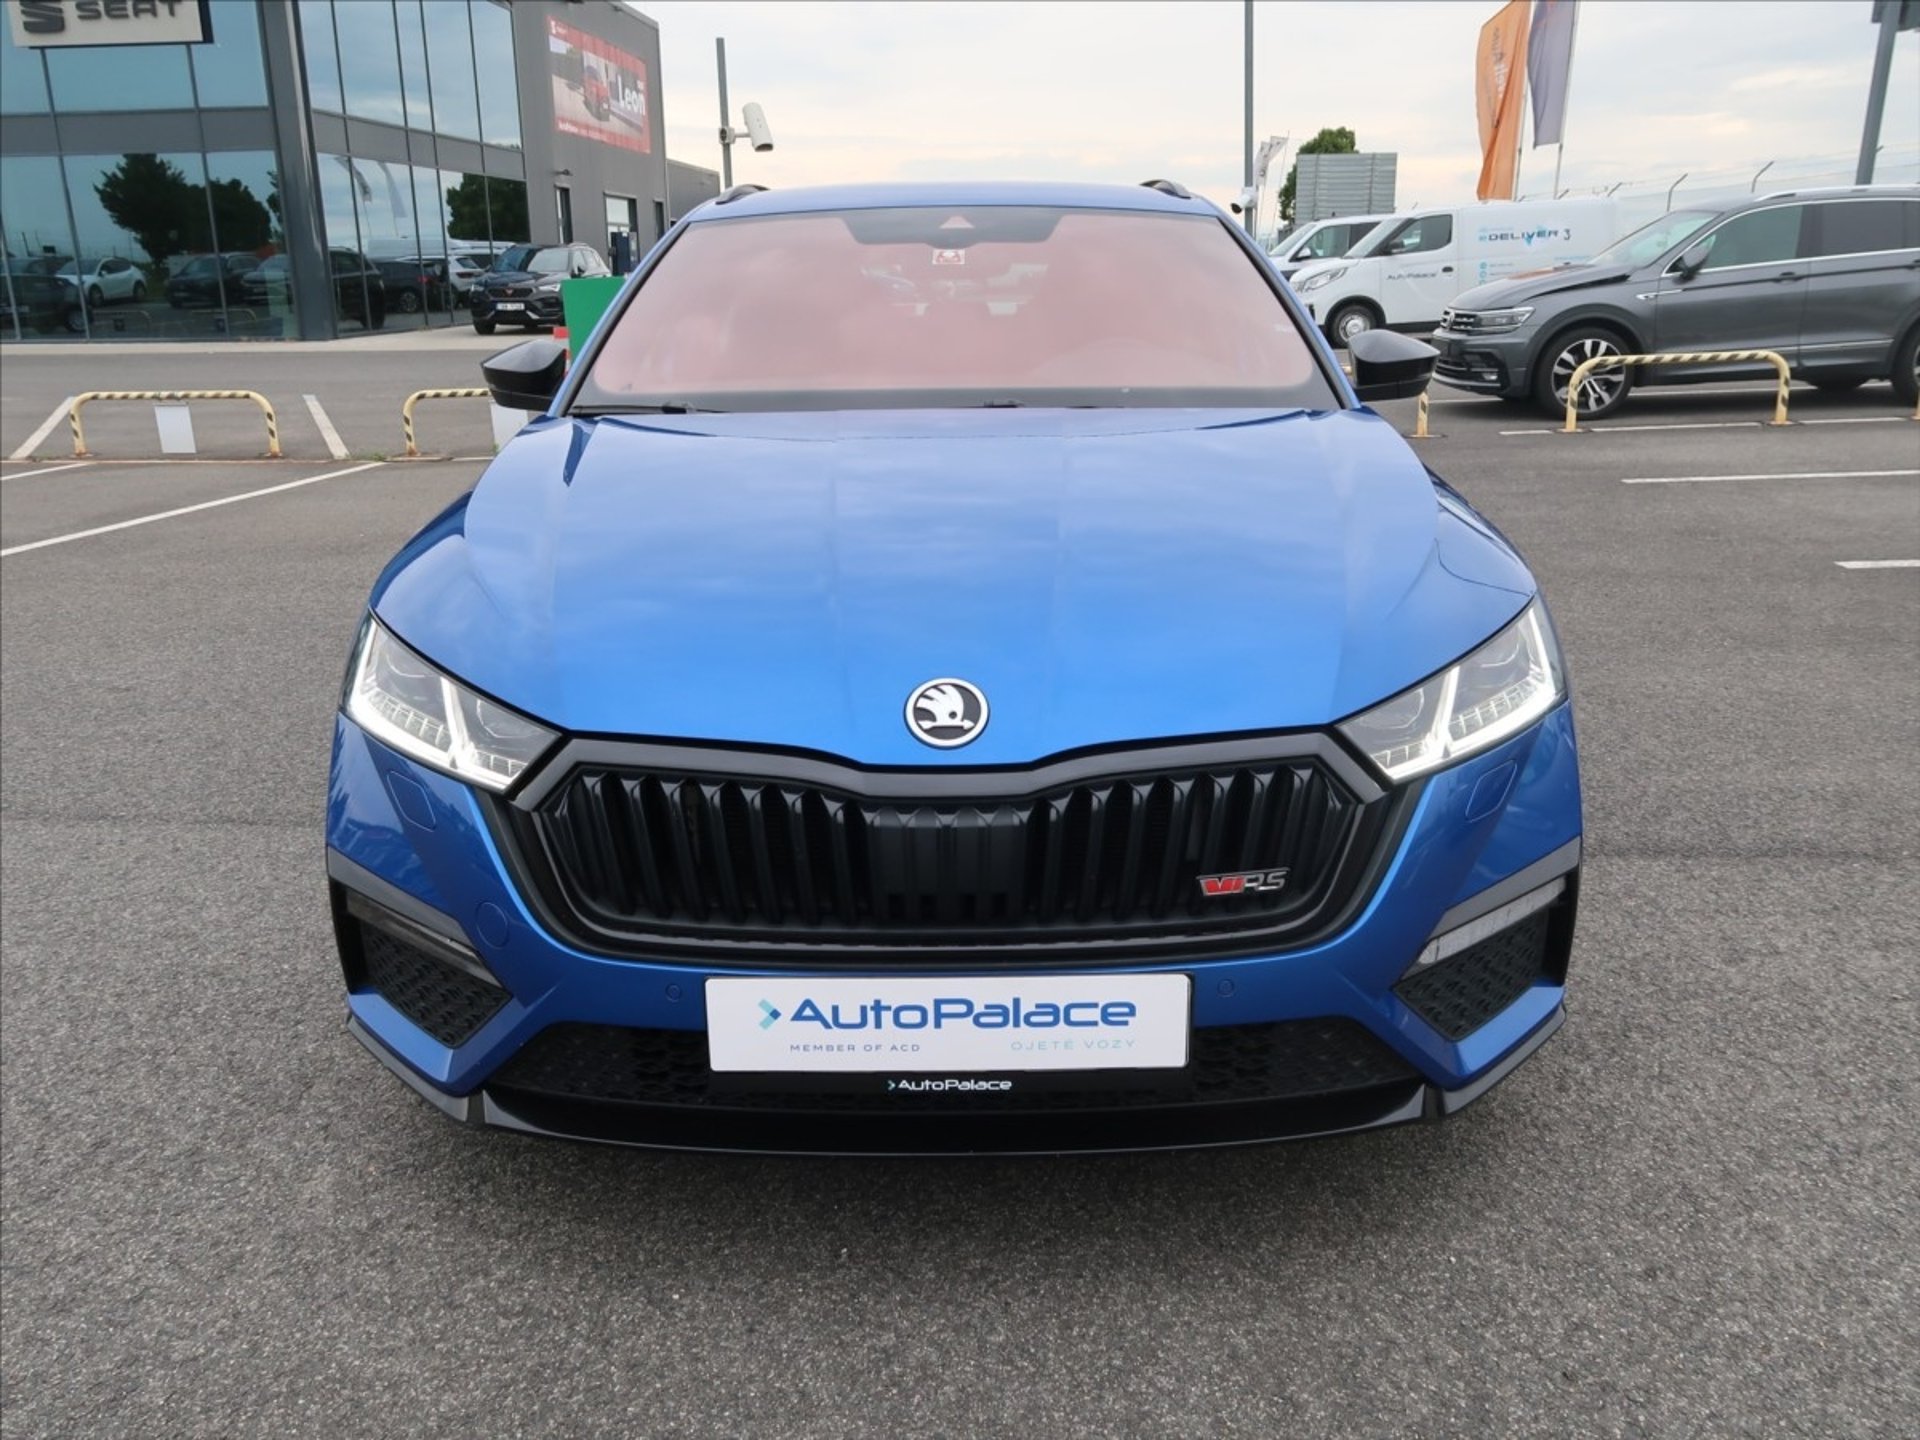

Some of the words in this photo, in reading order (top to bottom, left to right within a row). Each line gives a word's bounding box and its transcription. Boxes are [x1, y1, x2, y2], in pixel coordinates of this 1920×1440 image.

[76, 0, 182, 20] SEAT
[1563, 228, 1571, 241] 3
[790, 997, 1137, 1030] AutoPalace
[789, 1043, 856, 1052] MEMBER
[863, 1043, 883, 1052] OF
[890, 1043, 920, 1052] ACD
[1083, 1039, 1136, 1049] VOZY
[898, 1079, 1012, 1091] AutoPalace
